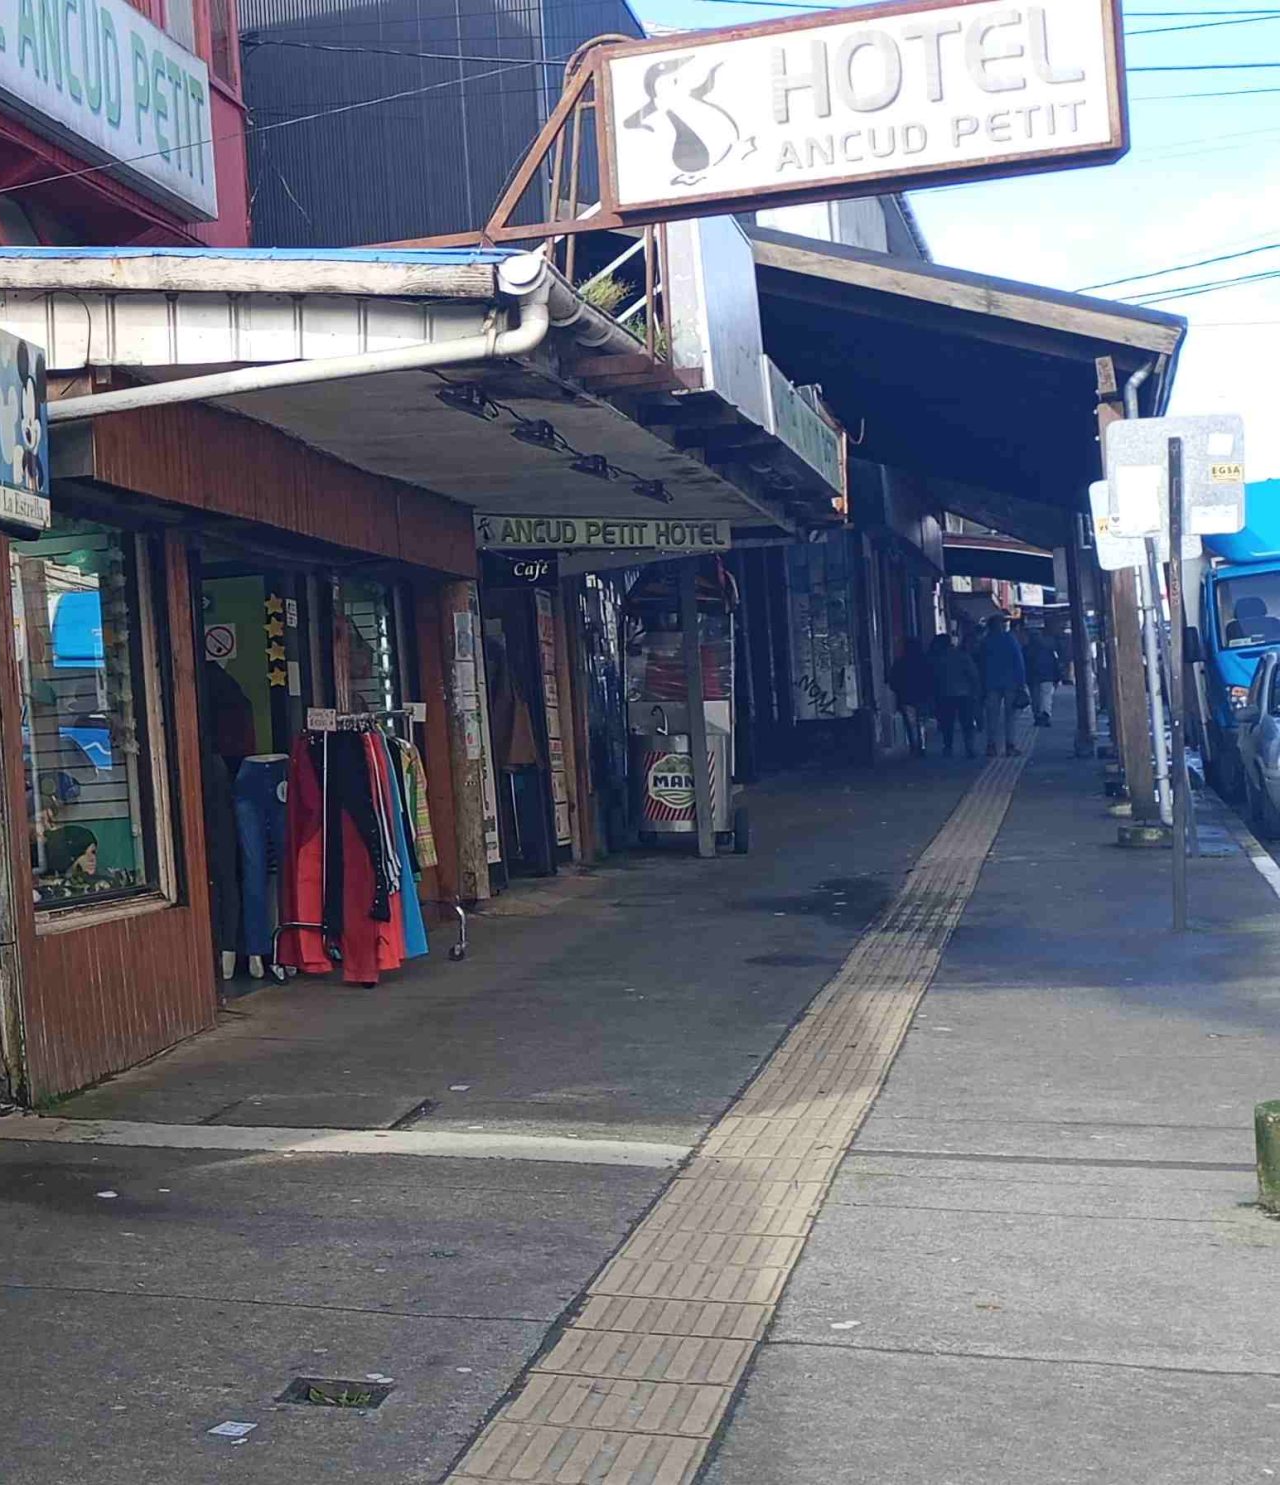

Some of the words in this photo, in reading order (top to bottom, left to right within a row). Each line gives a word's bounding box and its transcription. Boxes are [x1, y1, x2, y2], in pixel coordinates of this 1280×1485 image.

[770, 6, 1087, 125] HOTEL
[20, 0, 122, 130] ANCUD
[130, 30, 205, 187] PETIT
[775, 122, 928, 174] ANCUD
[951, 99, 1087, 150] PETIT
[1211, 466, 1241, 475] EGSA
[2, 488, 13, 514] La
[14, 492, 44, 521] Estrella
[501, 519, 577, 544] ANCUD
[585, 520, 649, 545] PETIT
[654, 521, 726, 546] HOTEL
[513, 559, 549, 581] Café
[653, 774, 696, 788] MAN
